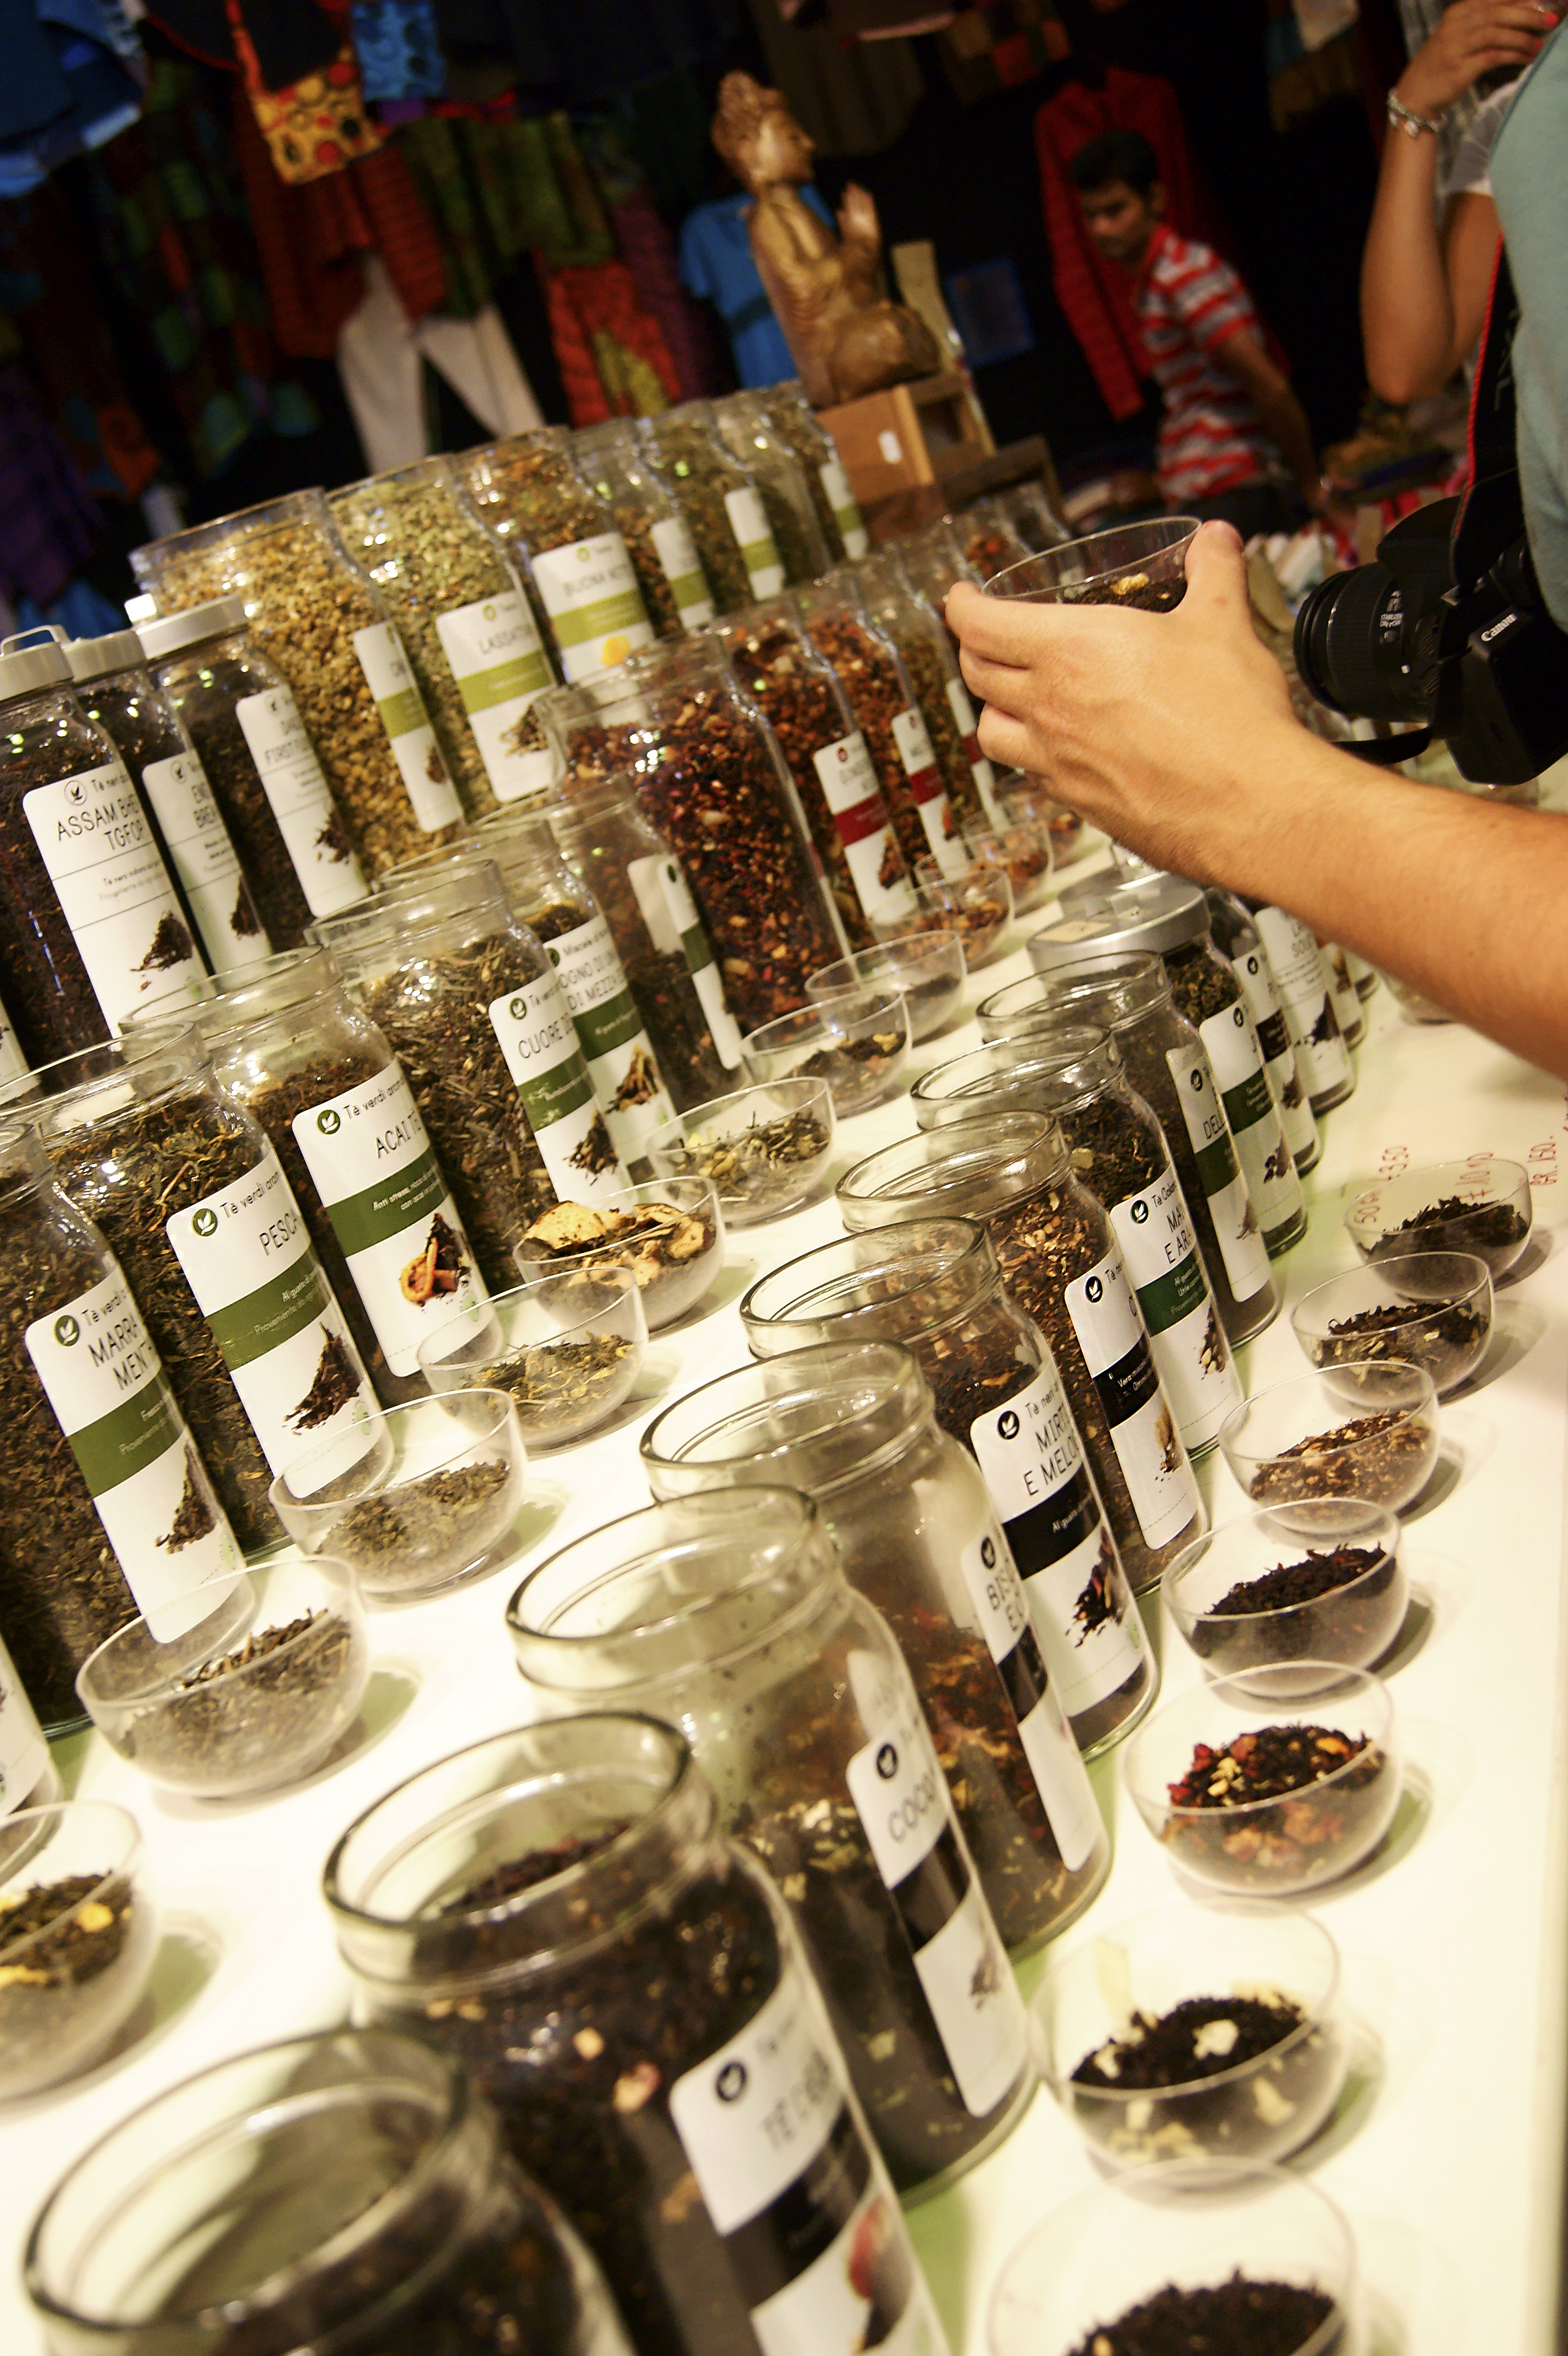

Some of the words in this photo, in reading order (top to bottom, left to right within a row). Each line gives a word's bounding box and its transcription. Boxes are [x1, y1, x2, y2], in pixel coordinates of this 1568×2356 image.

[1481, 613, 1518, 642] Canon
[58, 802, 119, 841] ASSAM
[518, 1020, 563, 1059] CUORE
[343, 1103, 361, 1121] Tè
[362, 1088, 386, 1110] verdi
[220, 1200, 239, 1219] Tè
[240, 1182, 265, 1209] verdi
[1150, 1194, 1163, 1208] Tè
[1164, 1242, 1176, 1264] E
[282, 1289, 291, 1303] Al
[81, 1308, 101, 1326] Tè
[1024, 1470, 1038, 1497] E
